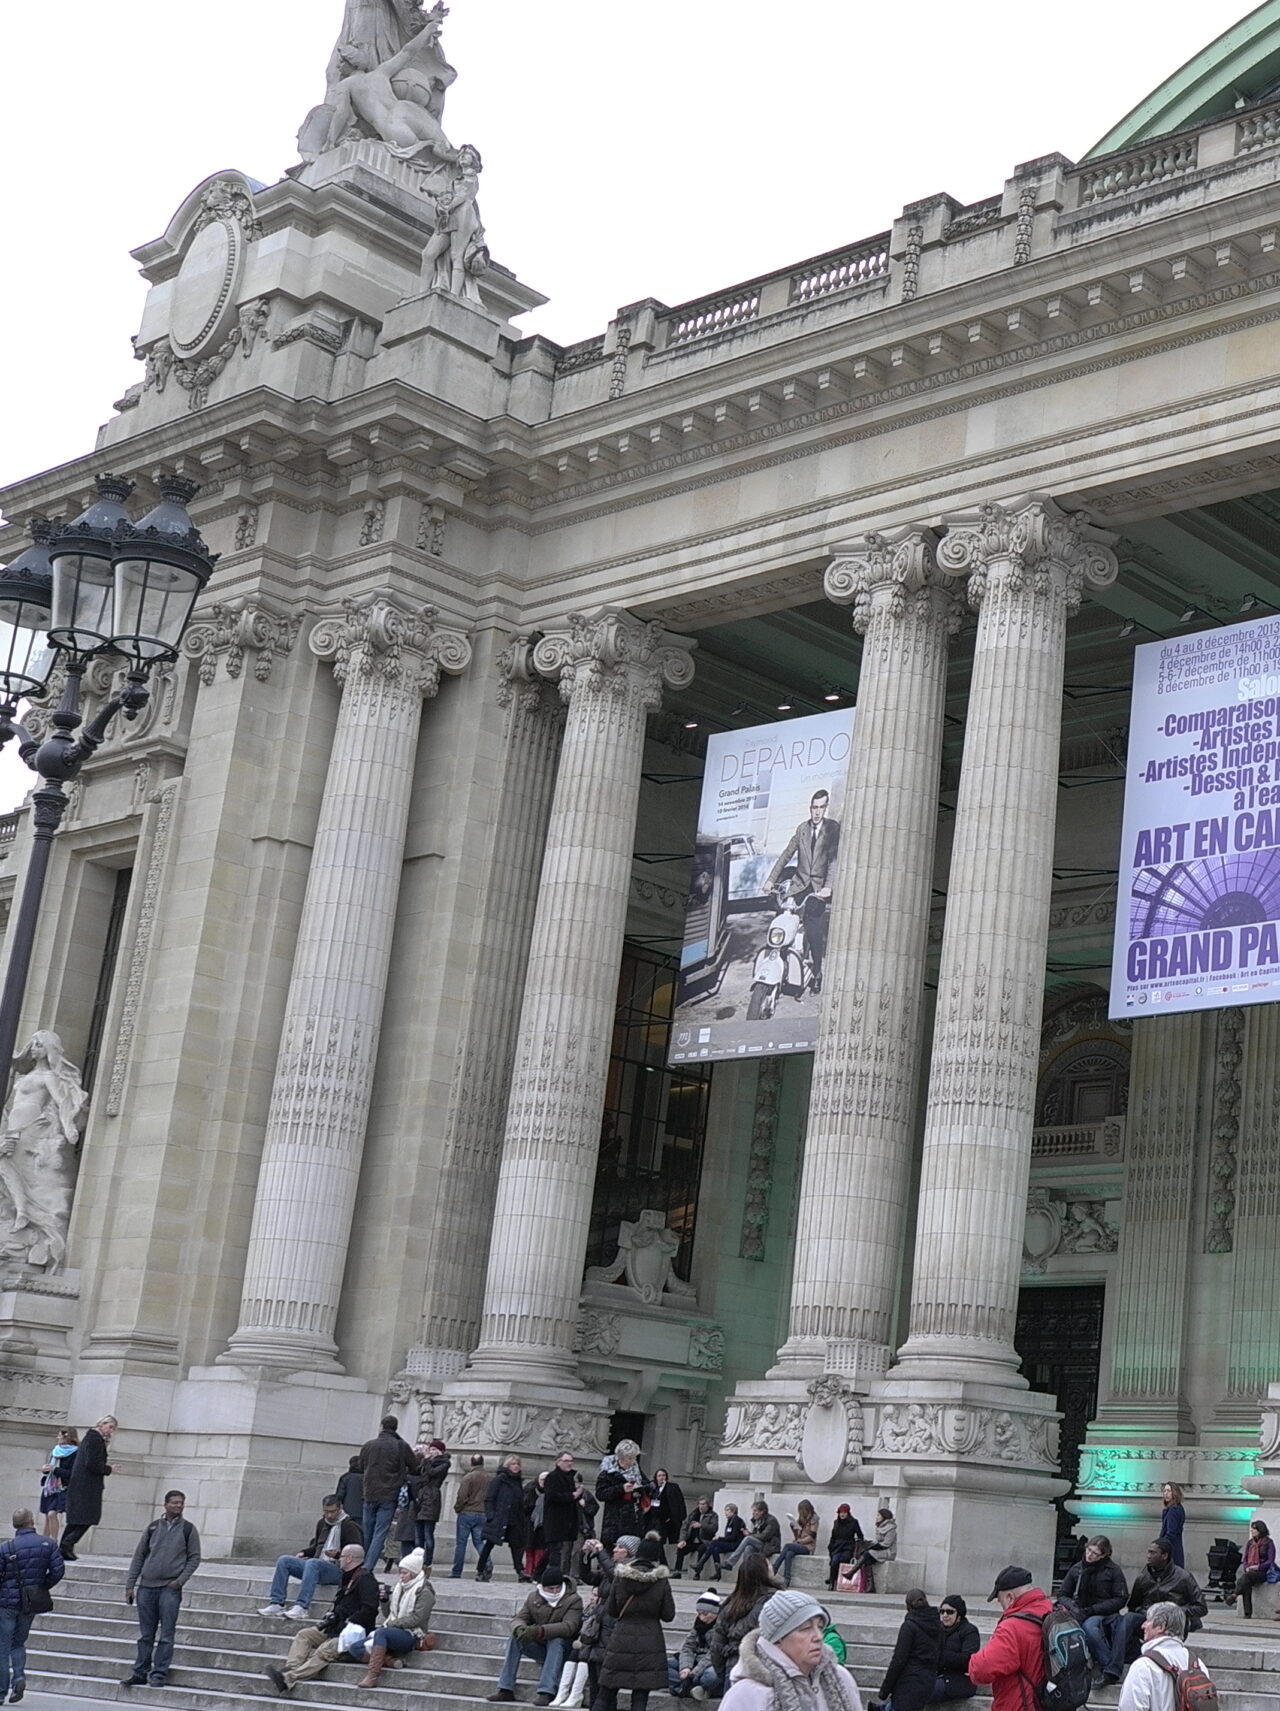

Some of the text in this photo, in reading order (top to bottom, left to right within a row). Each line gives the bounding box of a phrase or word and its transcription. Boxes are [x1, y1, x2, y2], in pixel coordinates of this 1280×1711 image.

[1159, 660, 1165, 670] 4
[1167, 649, 1216, 669] décembre
[1219, 646, 1230, 659] de
[1235, 638, 1262, 655] 14h00
[1265, 637, 1270, 649] à
[1160, 622, 1280, 658] du 4 au 8 décembre 2013
[1158, 684, 1164, 694] 8
[1166, 672, 1214, 693] décembre
[1217, 669, 1229, 682] de
[1233, 662, 1260, 679] 11h00
[1263, 662, 1269, 673] à
[1159, 668, 1182, 683] 5-6-7
[1185, 657, 1233, 678] décembre
[1237, 653, 1249, 666] de
[1253, 646, 1280, 663] 11h00
[1193, 720, 1272, 751] -Artistes
[1139, 752, 1218, 783] -Artistes
[1183, 765, 1253, 796] -Dessin
[1257, 765, 1270, 785] &
[719, 784, 760, 798] Grand Palais
[1234, 787, 1245, 811] à
[1133, 823, 1190, 868] ART
[1194, 816, 1229, 858] EN
[1127, 930, 1233, 983] GRAND
